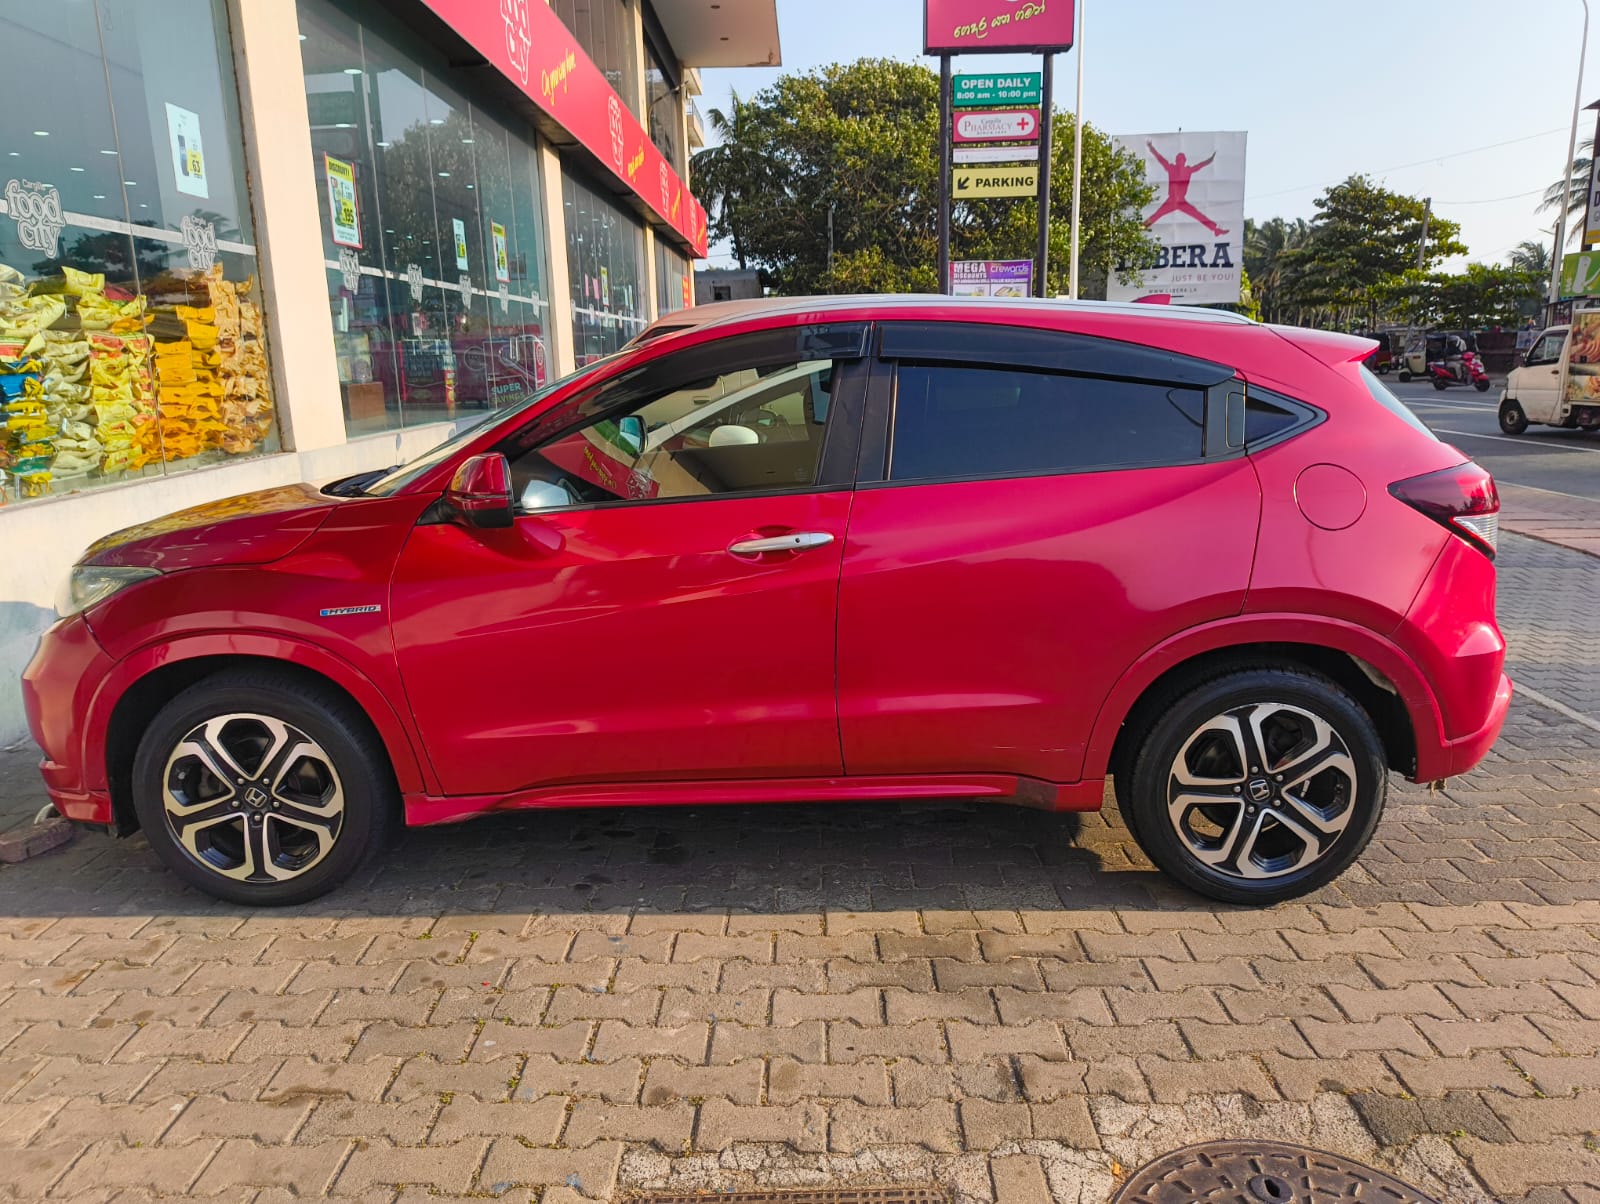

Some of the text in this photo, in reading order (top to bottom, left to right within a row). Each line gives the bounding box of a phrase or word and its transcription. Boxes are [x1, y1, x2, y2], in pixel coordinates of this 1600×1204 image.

[961, 78, 1031, 89] OPEN DAILY
[975, 176, 1034, 188] PARKING
[5, 179, 66, 227] food
[18, 219, 60, 258] city
[181, 216, 218, 252] food
[188, 247, 215, 275] city
[954, 262, 987, 273] MEGA
[1197, 274, 1207, 282] BE
[1211, 273, 1234, 281] YOU!
[491, 382, 521, 395] SUPER
[329, 605, 377, 614] HYBRID
